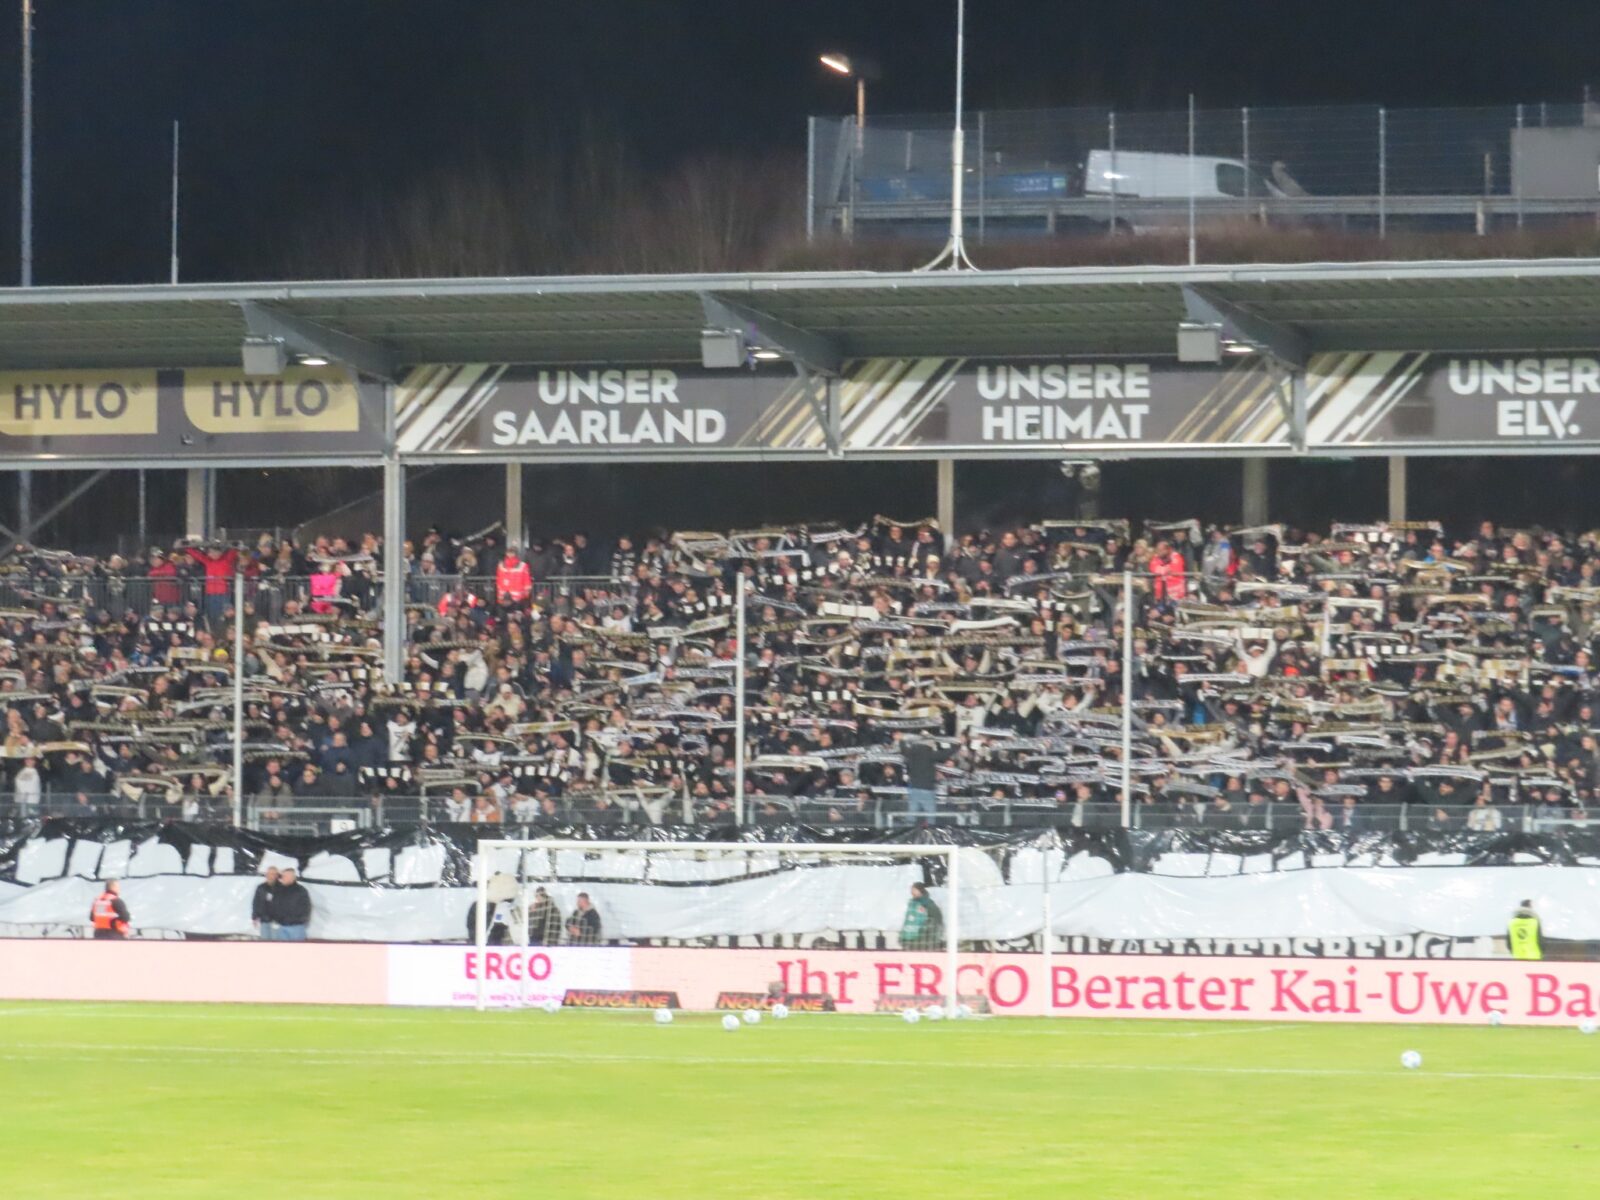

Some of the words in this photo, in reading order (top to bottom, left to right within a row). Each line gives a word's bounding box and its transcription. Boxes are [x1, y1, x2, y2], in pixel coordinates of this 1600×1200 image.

[14, 382, 128, 420] HYLO
[212, 379, 330, 417] HYLO
[537, 369, 680, 405] UNSER
[976, 364, 1151, 400] UNSERE
[492, 408, 727, 445] SAARLAND
[982, 403, 1149, 441] HEIMAT
[1497, 399, 1581, 440] ELV.
[465, 952, 552, 981] ERGO
[777, 959, 858, 1004] Ihr
[874, 962, 1029, 1008] ERGO
[1050, 966, 1255, 1012] Berater
[1270, 966, 1508, 1015] Kai-Uwe
[1526, 973, 1600, 1018] Ba
